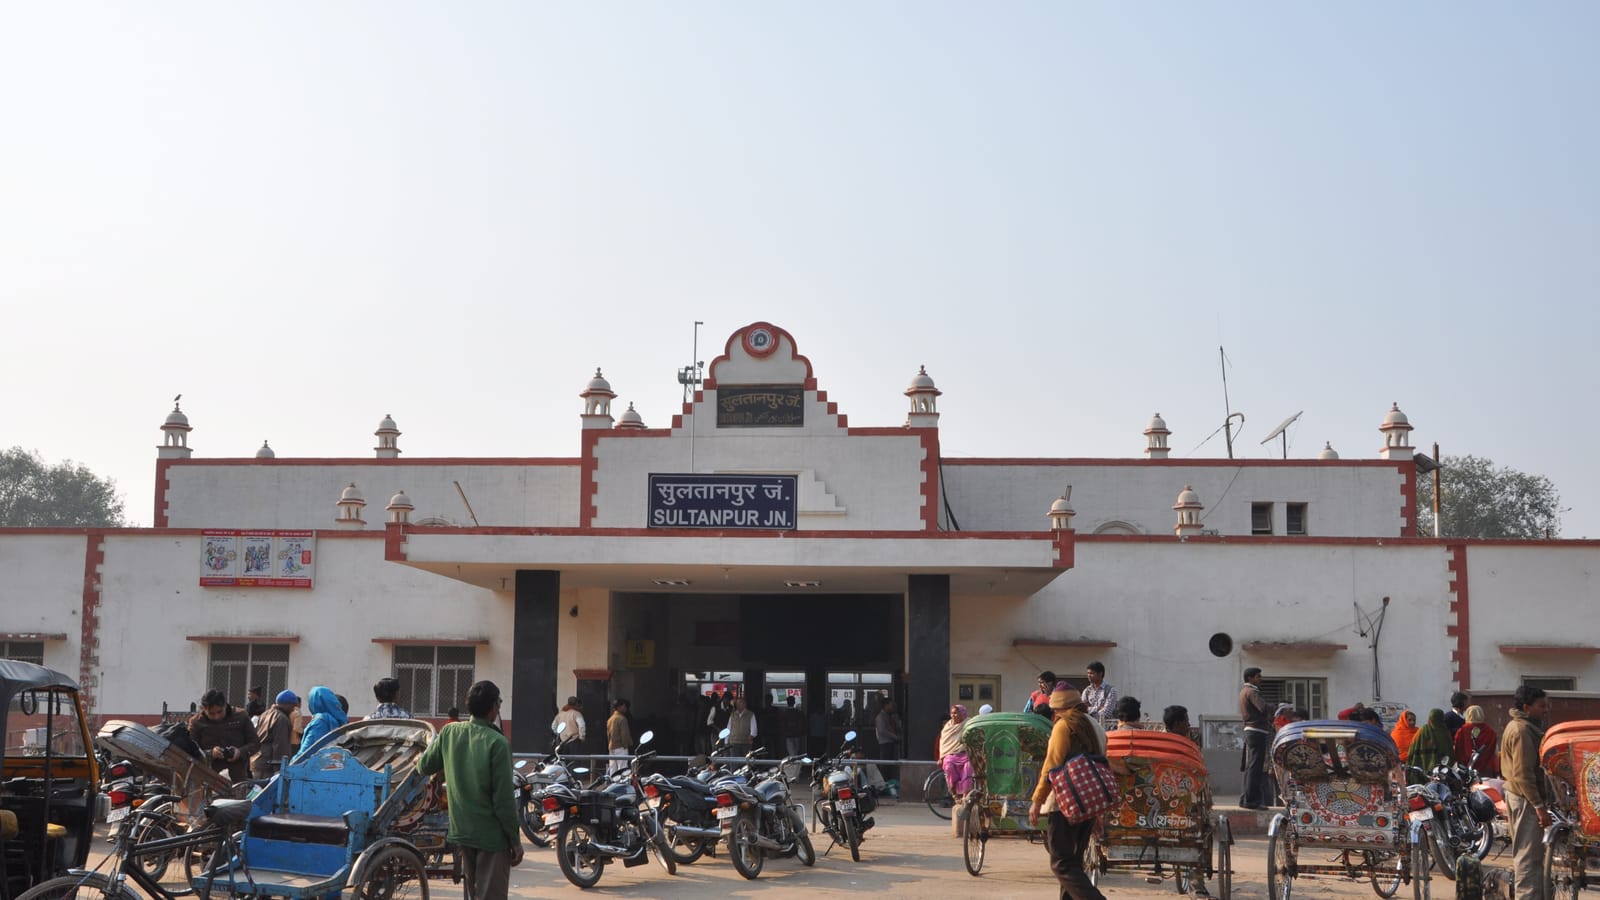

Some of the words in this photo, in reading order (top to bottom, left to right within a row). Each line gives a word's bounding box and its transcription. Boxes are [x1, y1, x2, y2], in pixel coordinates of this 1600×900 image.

[720, 393, 784, 412] सुलतानपुर
[656, 483, 757, 506] सुलतानपुर
[762, 479, 790, 500] जं.
[654, 509, 760, 526] SULTANPUR
[763, 510, 791, 527] JN.
